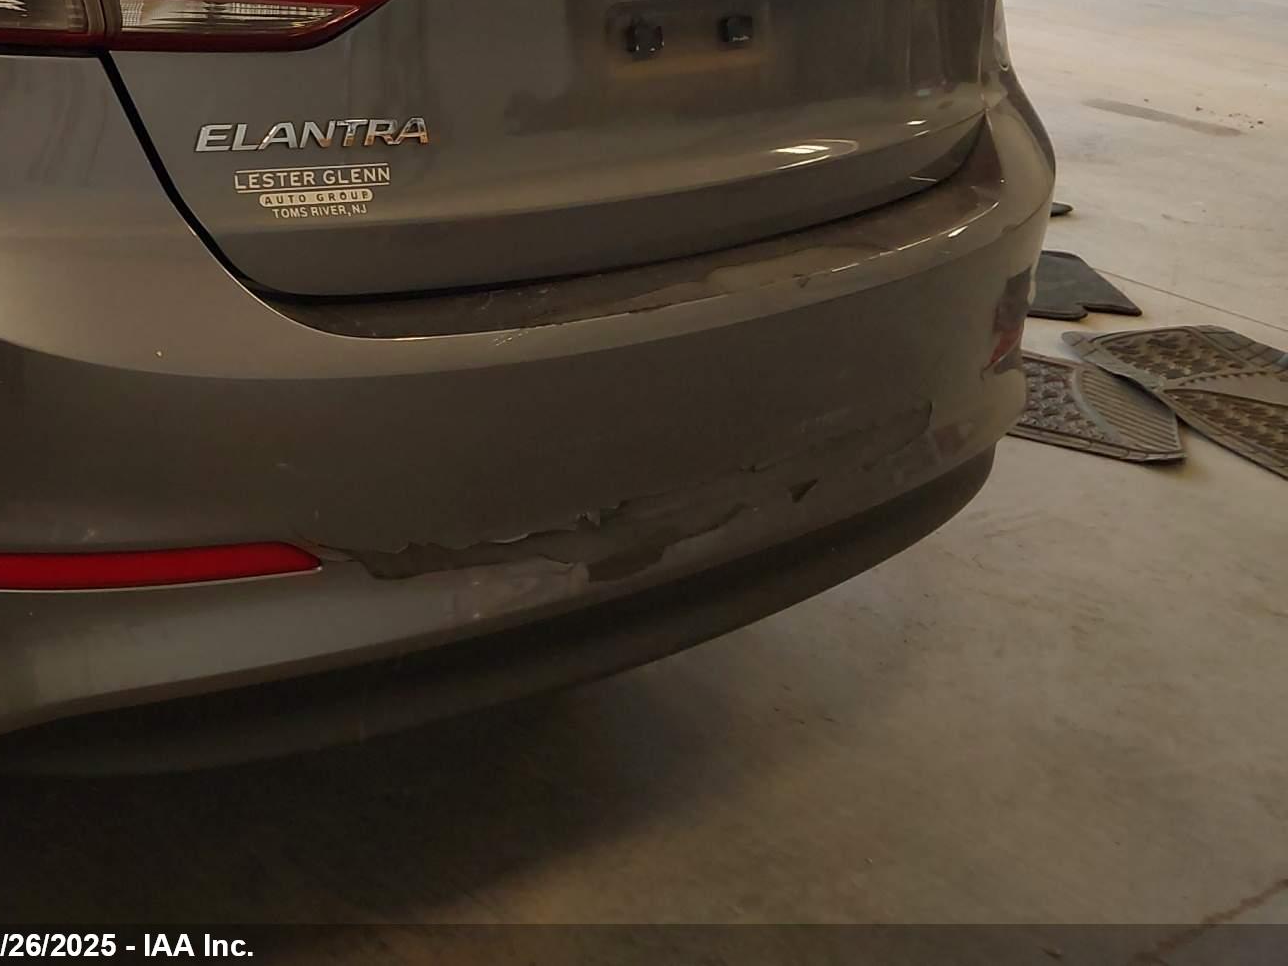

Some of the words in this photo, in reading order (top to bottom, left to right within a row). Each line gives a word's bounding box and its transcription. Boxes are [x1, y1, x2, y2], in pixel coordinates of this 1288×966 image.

[194, 117, 430, 152] ELANTRA
[233, 170, 316, 190] LESTER
[322, 166, 391, 185] GLENN
[264, 192, 306, 205] AUTO
[315, 190, 370, 202] GROUP
[272, 206, 309, 219] TOMS
